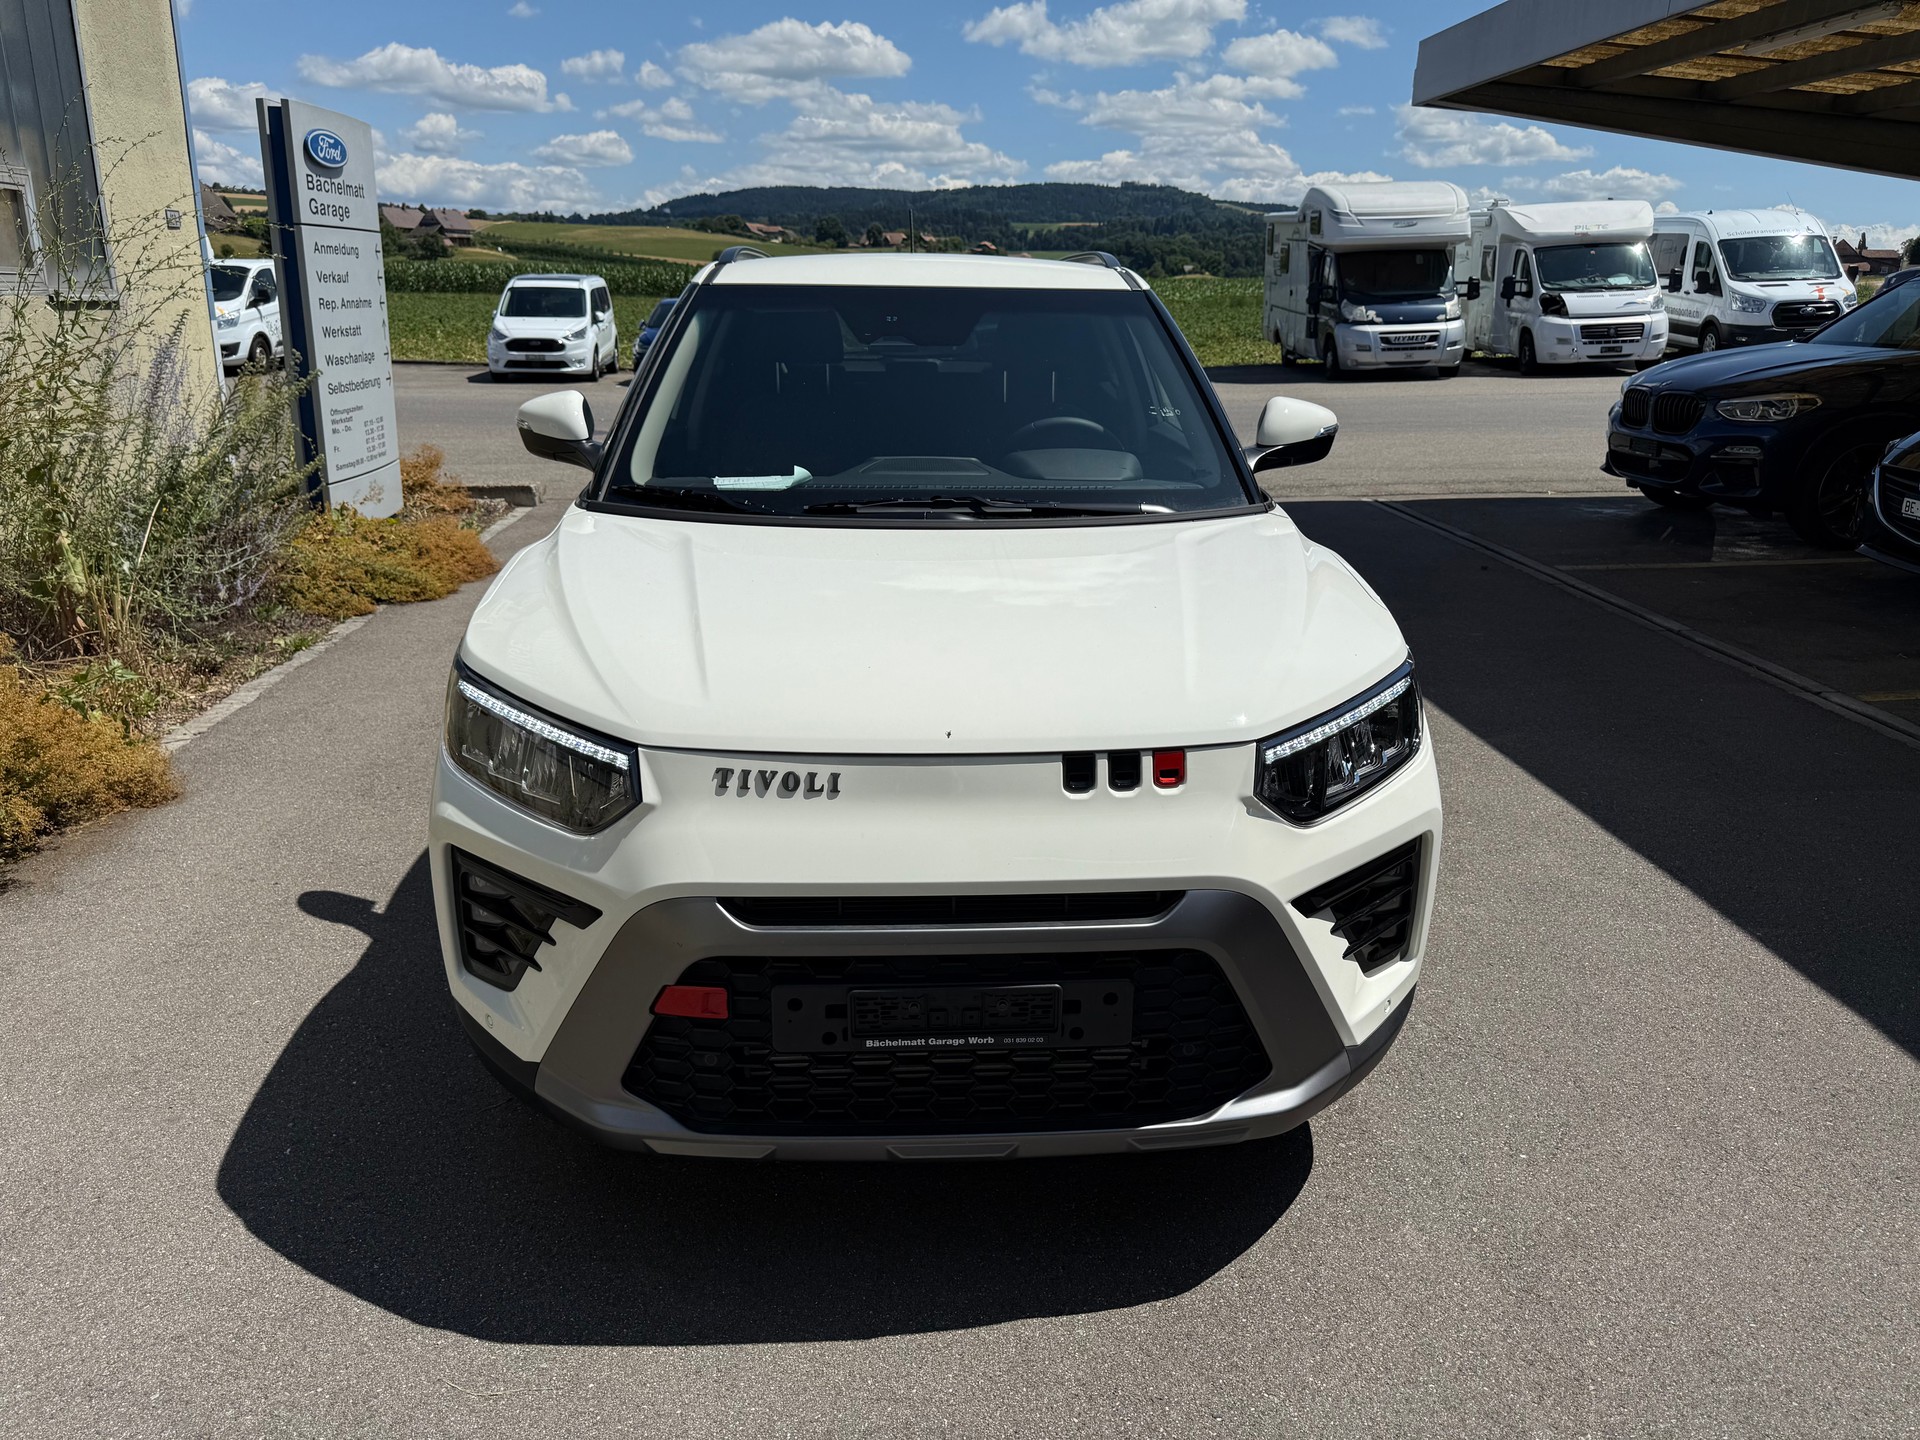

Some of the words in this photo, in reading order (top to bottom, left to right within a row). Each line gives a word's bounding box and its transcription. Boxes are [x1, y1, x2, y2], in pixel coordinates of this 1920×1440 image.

[317, 135, 342, 162] Ford
[306, 174, 365, 199] Bächelmatt
[309, 198, 350, 222] Garage
[1574, 223, 1609, 231] PILTE
[314, 241, 360, 259] Anmeldung
[316, 270, 349, 284] Verkauf
[319, 298, 339, 310] Rep.
[341, 297, 373, 309] Annahme
[322, 326, 362, 338] Werkstatt
[1393, 335, 1427, 343] HYMER
[325, 350, 376, 366] Waschanlage
[328, 376, 381, 395] Selbstbedienung
[331, 416, 353, 425] Werkstatt
[715, 767, 842, 793] TIVOLI
[866, 1038, 926, 1047] Bächelmatt
[928, 1038, 965, 1046] Garage
